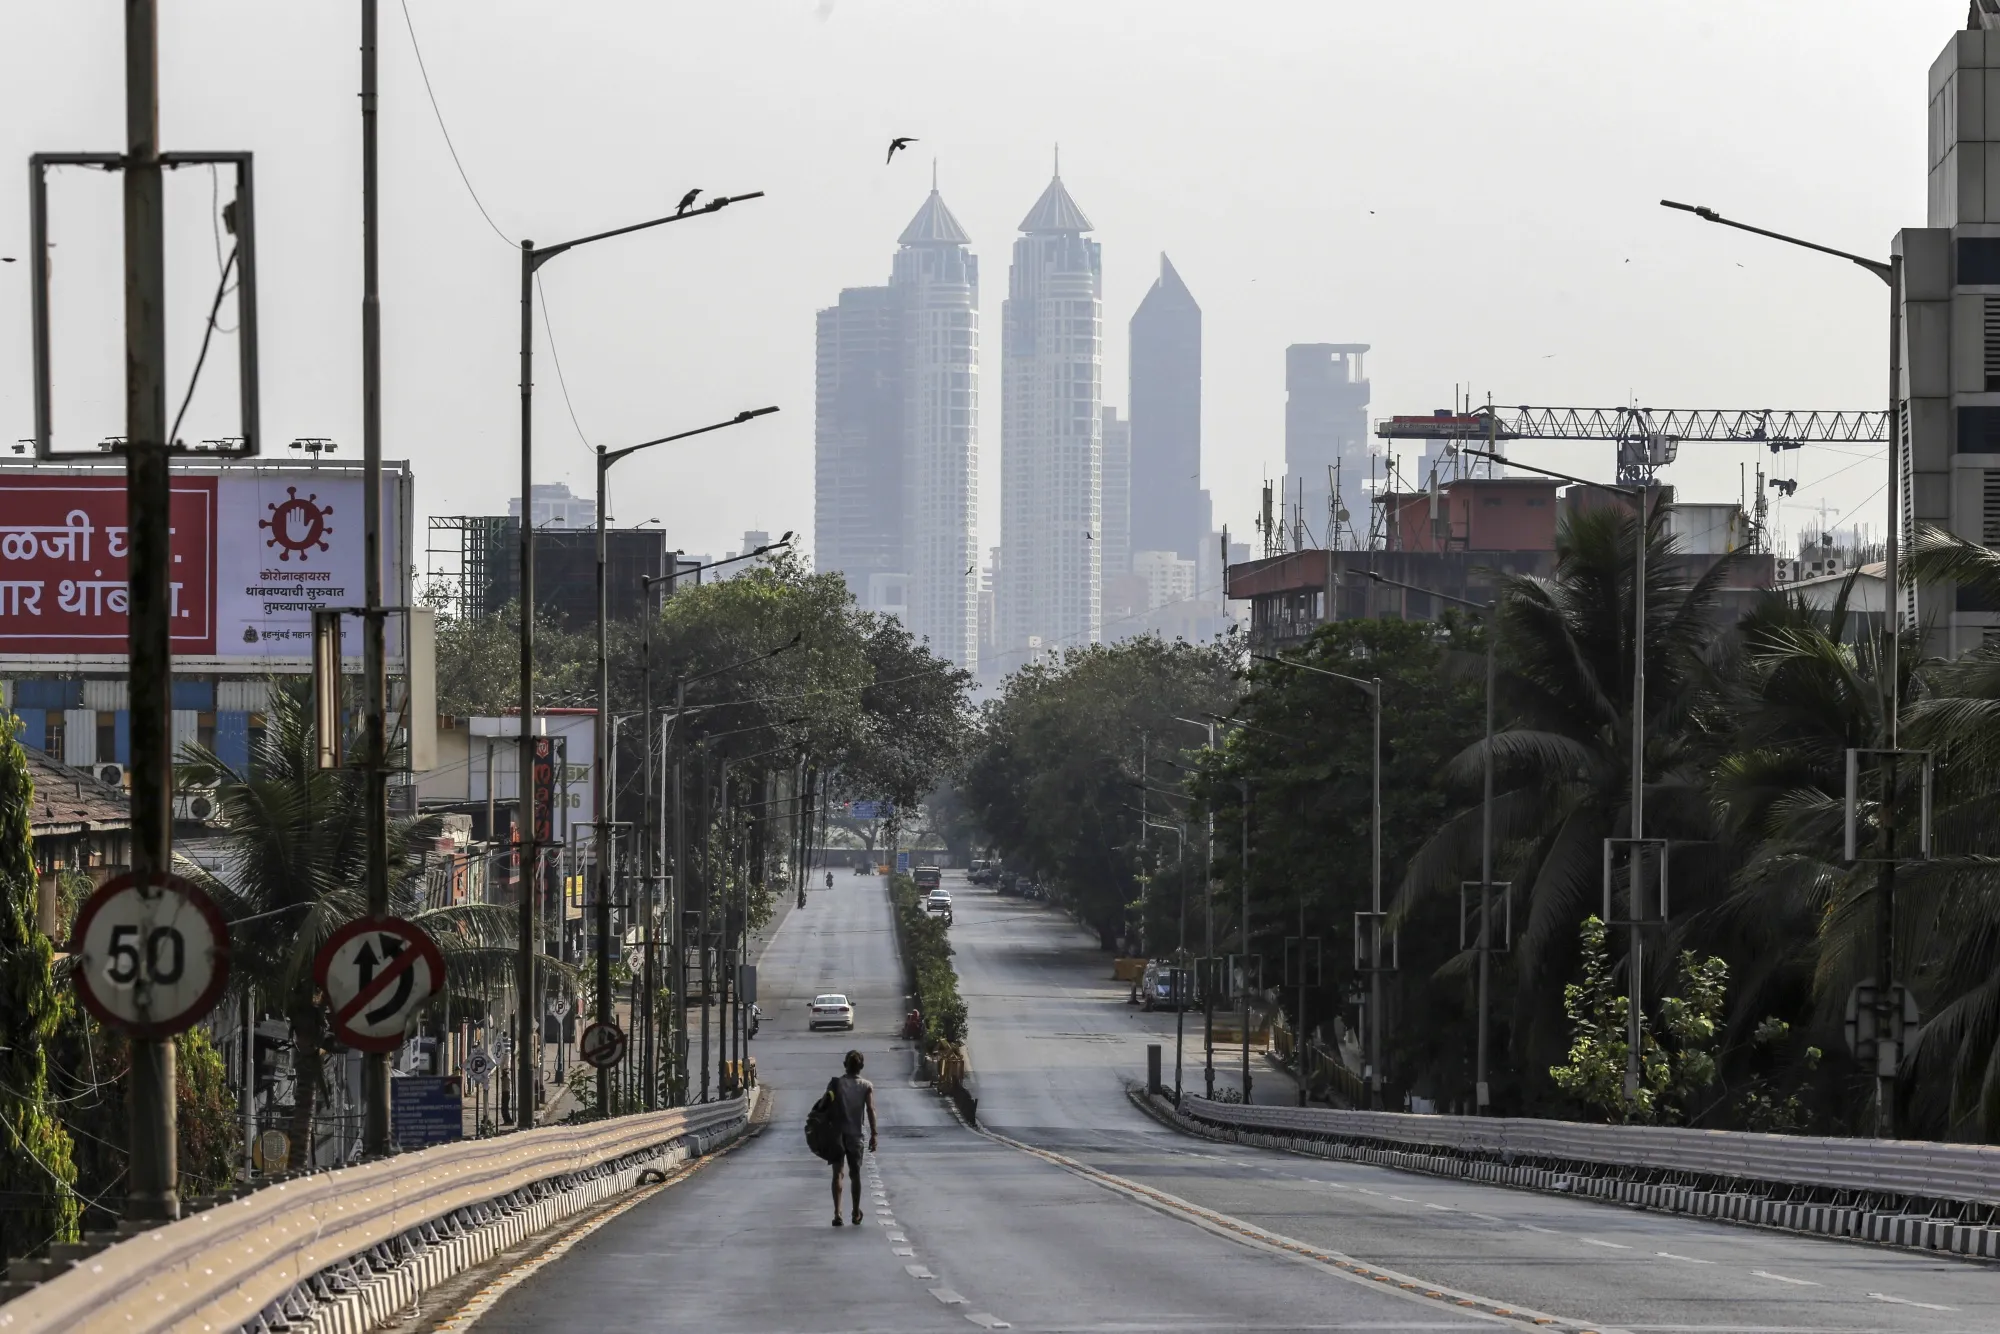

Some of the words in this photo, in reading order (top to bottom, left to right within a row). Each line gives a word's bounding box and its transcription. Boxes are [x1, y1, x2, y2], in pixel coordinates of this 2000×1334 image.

[259, 568, 331, 582] कोरोनाव्हायरस
[246, 583, 304, 597] थांबवण्याची
[306, 587, 345, 600] सुरुवात
[107, 925, 185, 985] 50
